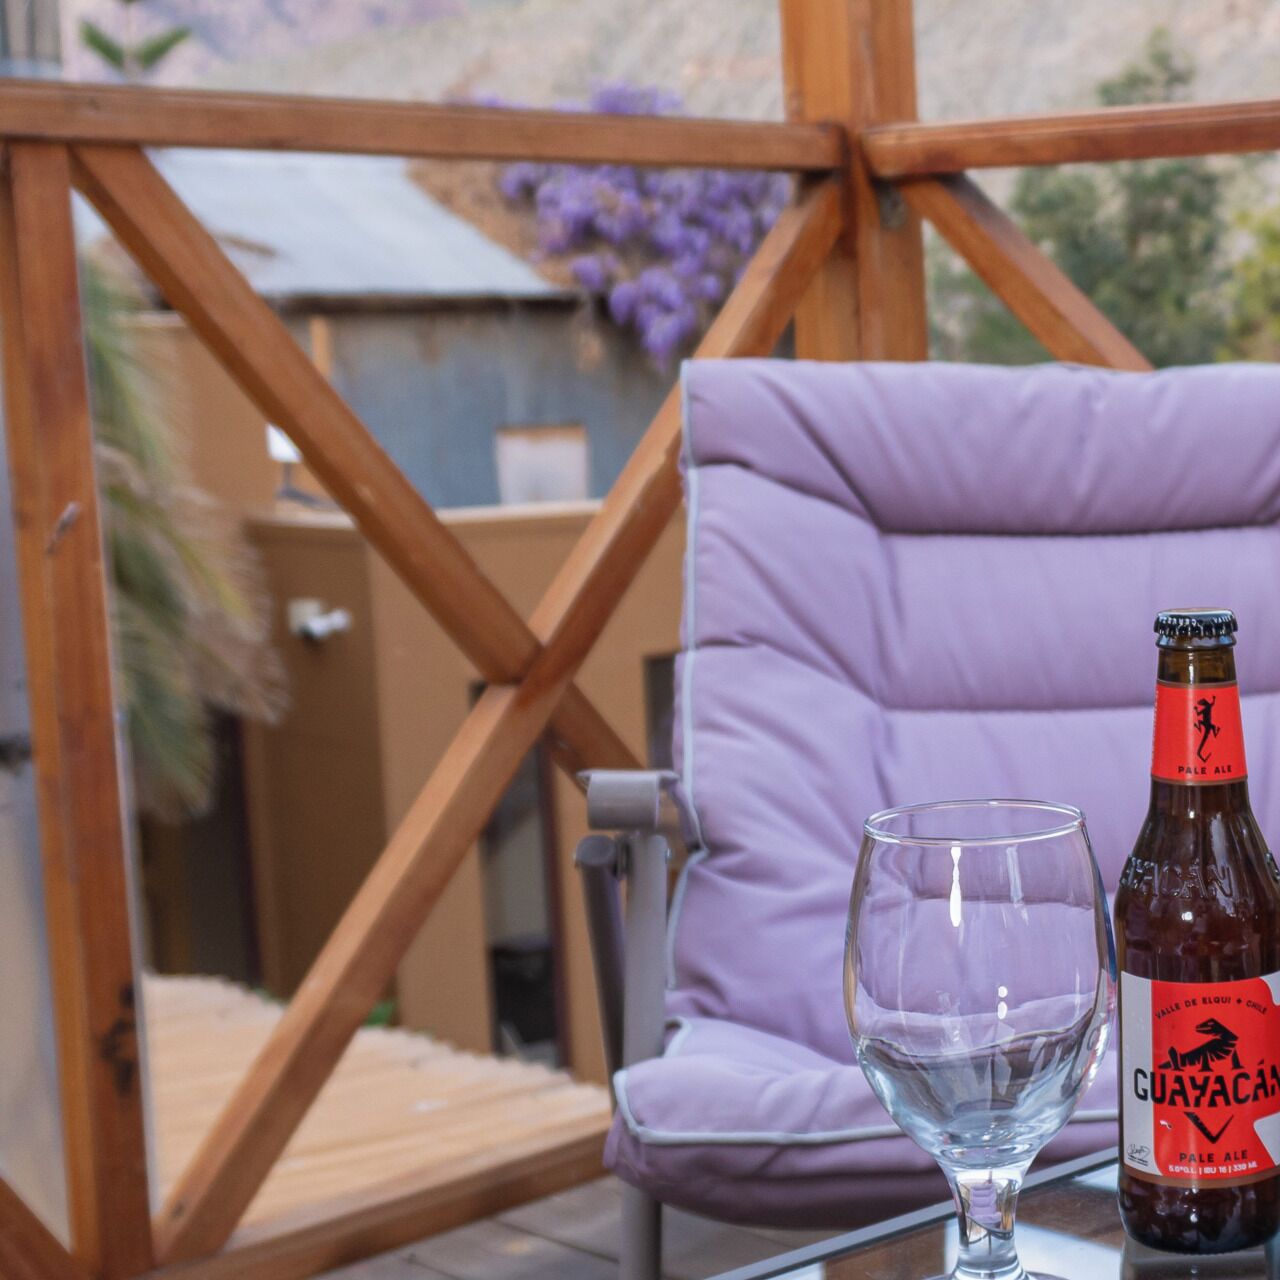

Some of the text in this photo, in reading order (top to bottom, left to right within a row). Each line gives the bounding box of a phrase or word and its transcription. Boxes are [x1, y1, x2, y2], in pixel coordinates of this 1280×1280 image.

[1178, 765, 1232, 775] PALE ALE
[1155, 997, 1268, 1019] VALLE DE ELQUI CHILE
[1179, 1149, 1248, 1163] PALE ALE
